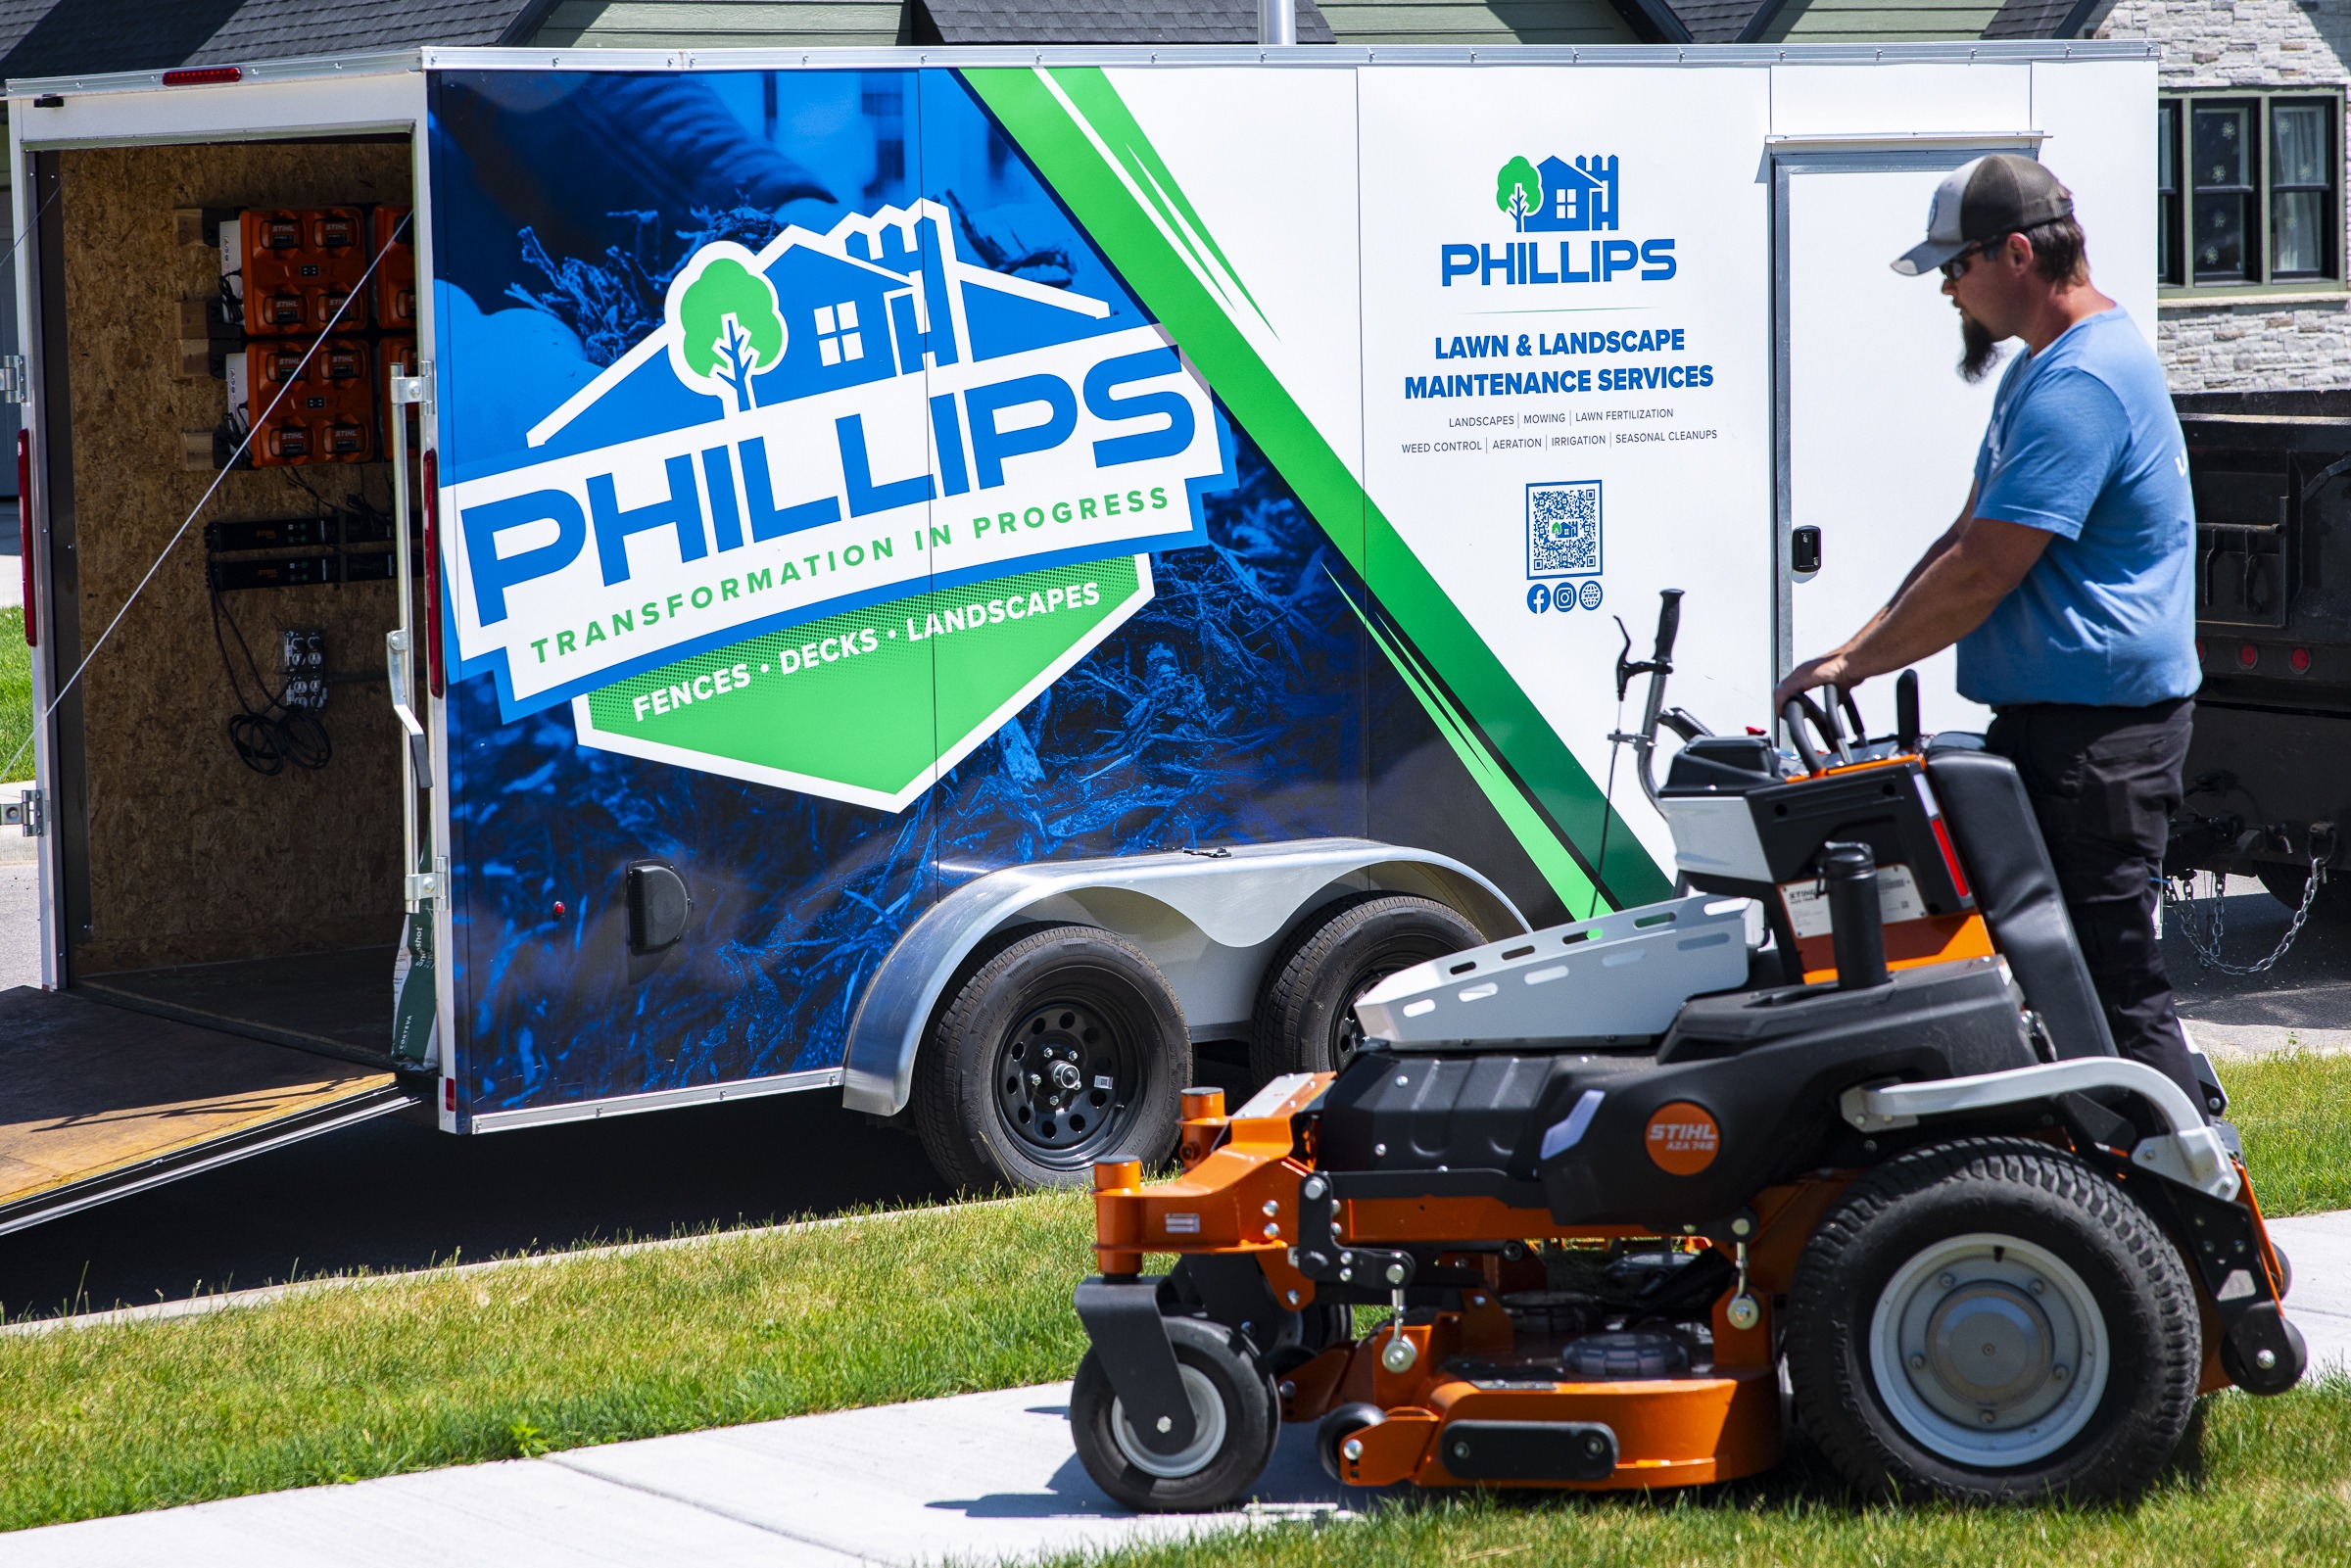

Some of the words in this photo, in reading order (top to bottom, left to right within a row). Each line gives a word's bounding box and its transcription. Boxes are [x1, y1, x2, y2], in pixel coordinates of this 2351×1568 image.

[1442, 239, 1677, 286] PHILLIPS
[1436, 335, 1510, 359] LAWN
[1516, 333, 1532, 356] &
[1540, 329, 1685, 356] LANDSCAPE
[1406, 370, 1592, 399] MAINTENANCE
[1598, 365, 1714, 392] SERVICES
[1449, 415, 1514, 428] LANDSCAPES
[1523, 412, 1566, 424] MOWING
[1575, 410, 1604, 422] LAWN
[1606, 408, 1674, 421] FERTILIZATION
[1492, 438, 1542, 450] AERATION
[1551, 435, 1606, 447] IRRIGATION
[1615, 432, 1665, 444] SEASONAL
[1668, 429, 1718, 442] CLEANUPS
[1401, 442, 1431, 453] WEED
[1433, 440, 1482, 452] CONTROL
[461, 344, 1195, 627] PHILLIPS
[531, 537, 893, 663] TRANSFORMATION
[915, 523, 951, 550] IN
[973, 487, 1168, 539] PROGRESS
[632, 663, 751, 722] FENCES
[779, 628, 879, 675] DECKS
[906, 582, 1100, 642] LANDSCAPES
[399, 1015, 412, 1050] CORTEVA
[1649, 1123, 1717, 1141] STIHL
